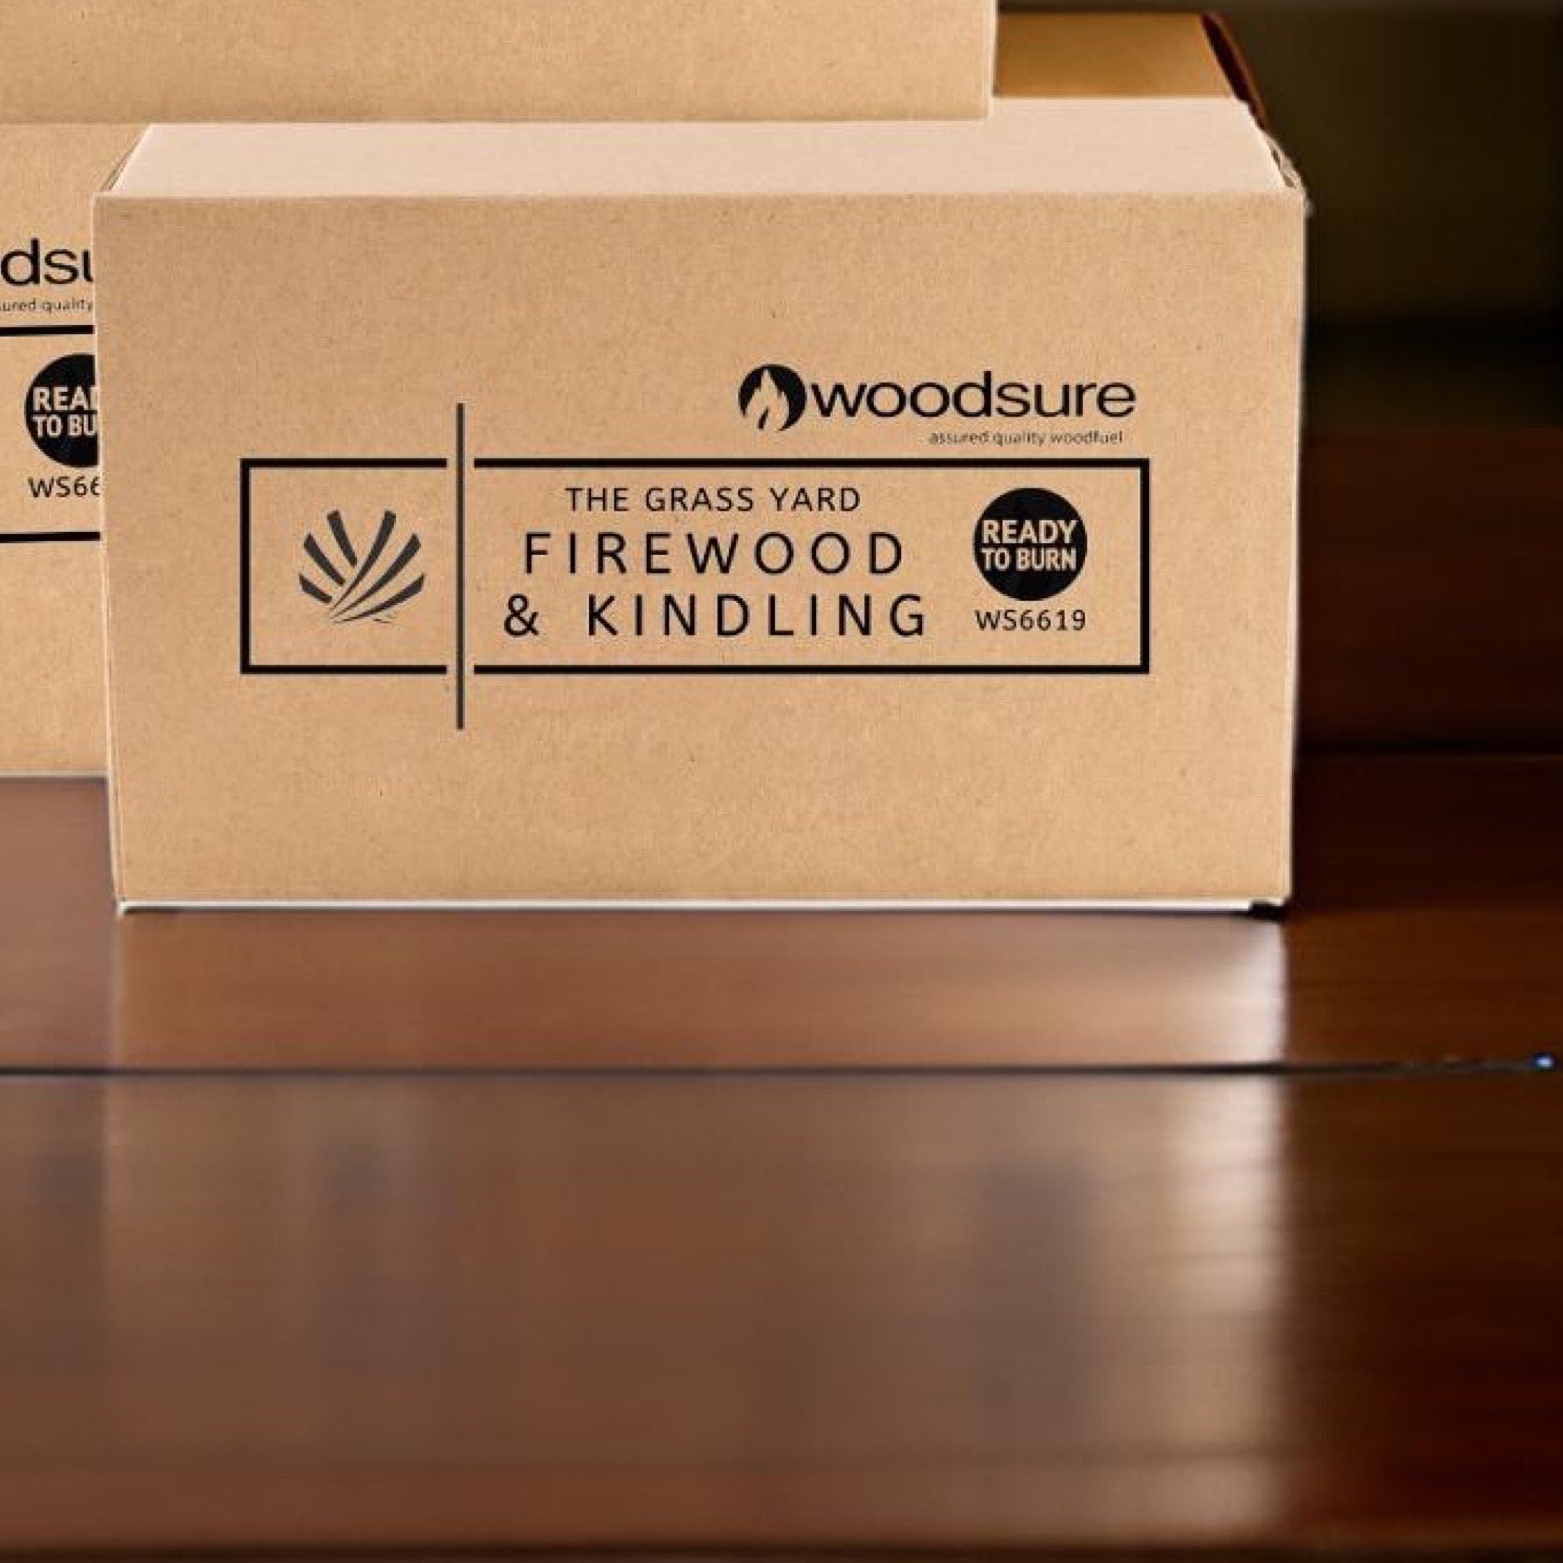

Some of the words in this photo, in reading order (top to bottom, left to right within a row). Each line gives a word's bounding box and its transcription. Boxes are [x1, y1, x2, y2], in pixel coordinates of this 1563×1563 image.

[810, 370, 1137, 418] woodsure
[32, 415, 62, 438] TO
[929, 430, 989, 445] assured
[993, 431, 1046, 446] quality
[1050, 430, 1123, 445] woodfuel
[563, 487, 630, 512] THE
[644, 485, 755, 512] GRASS
[769, 487, 861, 512] YARD
[982, 519, 1078, 544] READY
[524, 531, 902, 576] FIREWOOD
[982, 548, 1010, 572] TO
[1016, 548, 1078, 572] BURN
[503, 593, 540, 638] &
[588, 593, 924, 638] KINDLING
[974, 609, 1086, 632] WS6619
